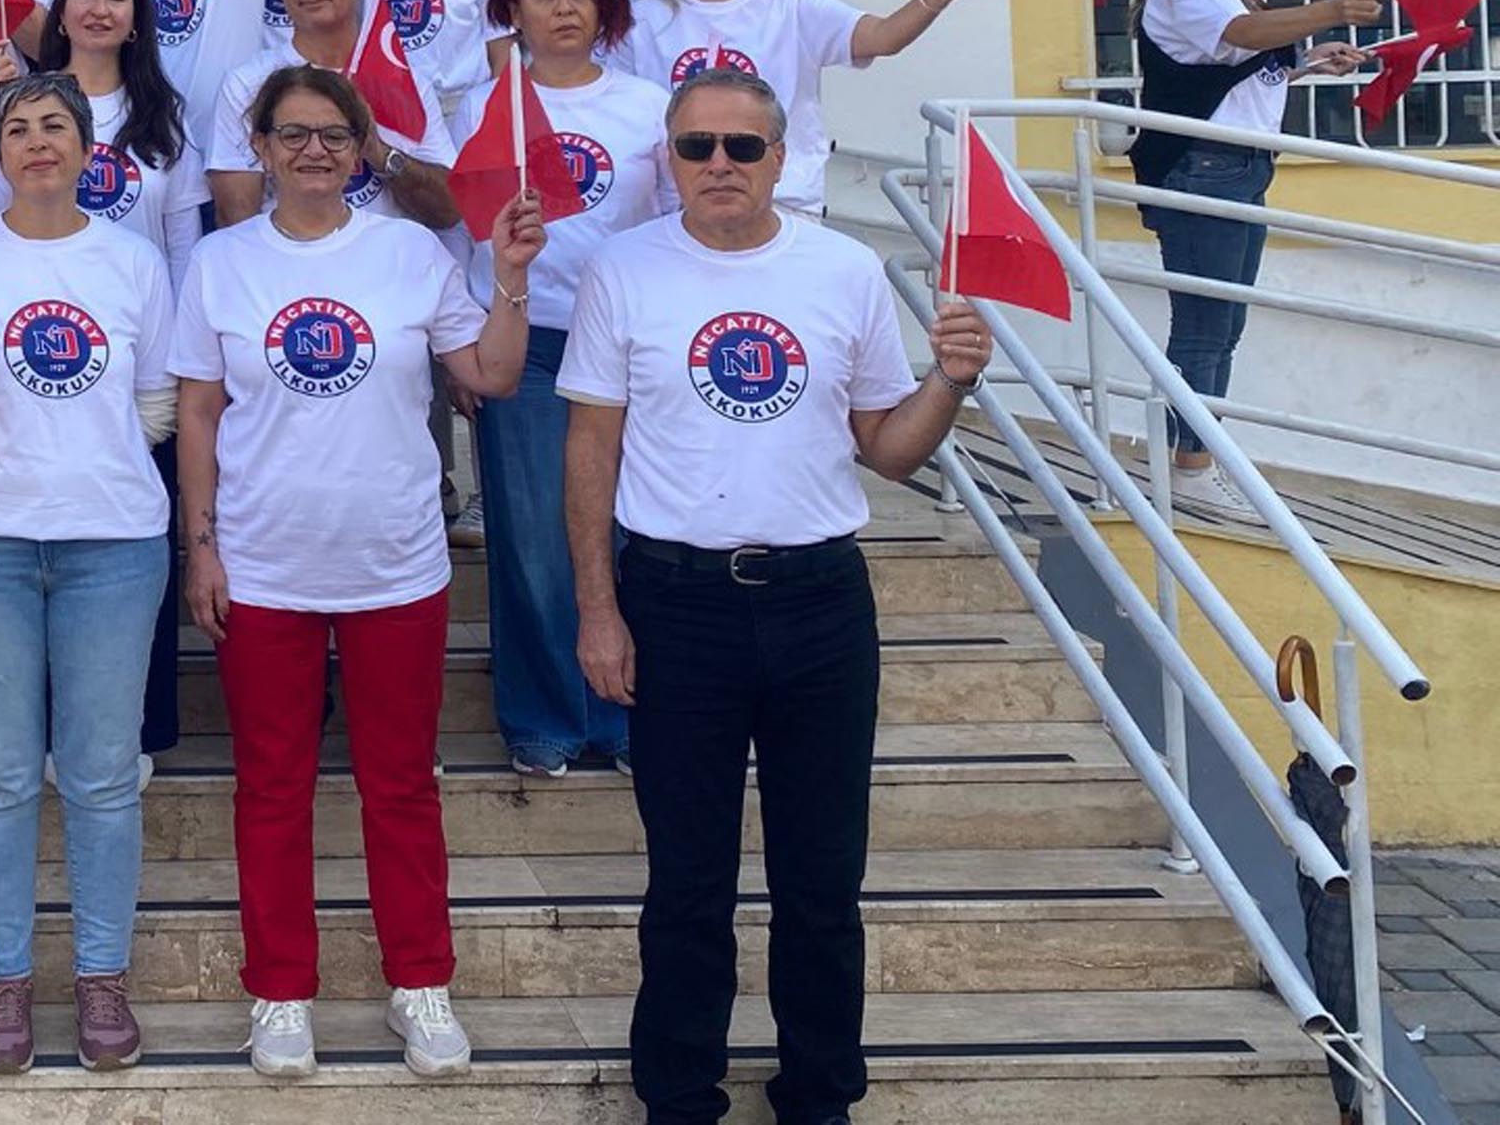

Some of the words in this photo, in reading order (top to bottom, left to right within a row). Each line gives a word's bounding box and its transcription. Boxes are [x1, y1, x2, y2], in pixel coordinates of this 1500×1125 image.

[9, 304, 101, 339] NECATİBEY
[270, 301, 368, 338] NECATİBEY
[695, 316, 801, 358] NECATİBEY
[12, 359, 102, 395] İLKOKULU
[274, 357, 367, 394] İLKOKULU
[698, 380, 801, 420] İLKOKULU
